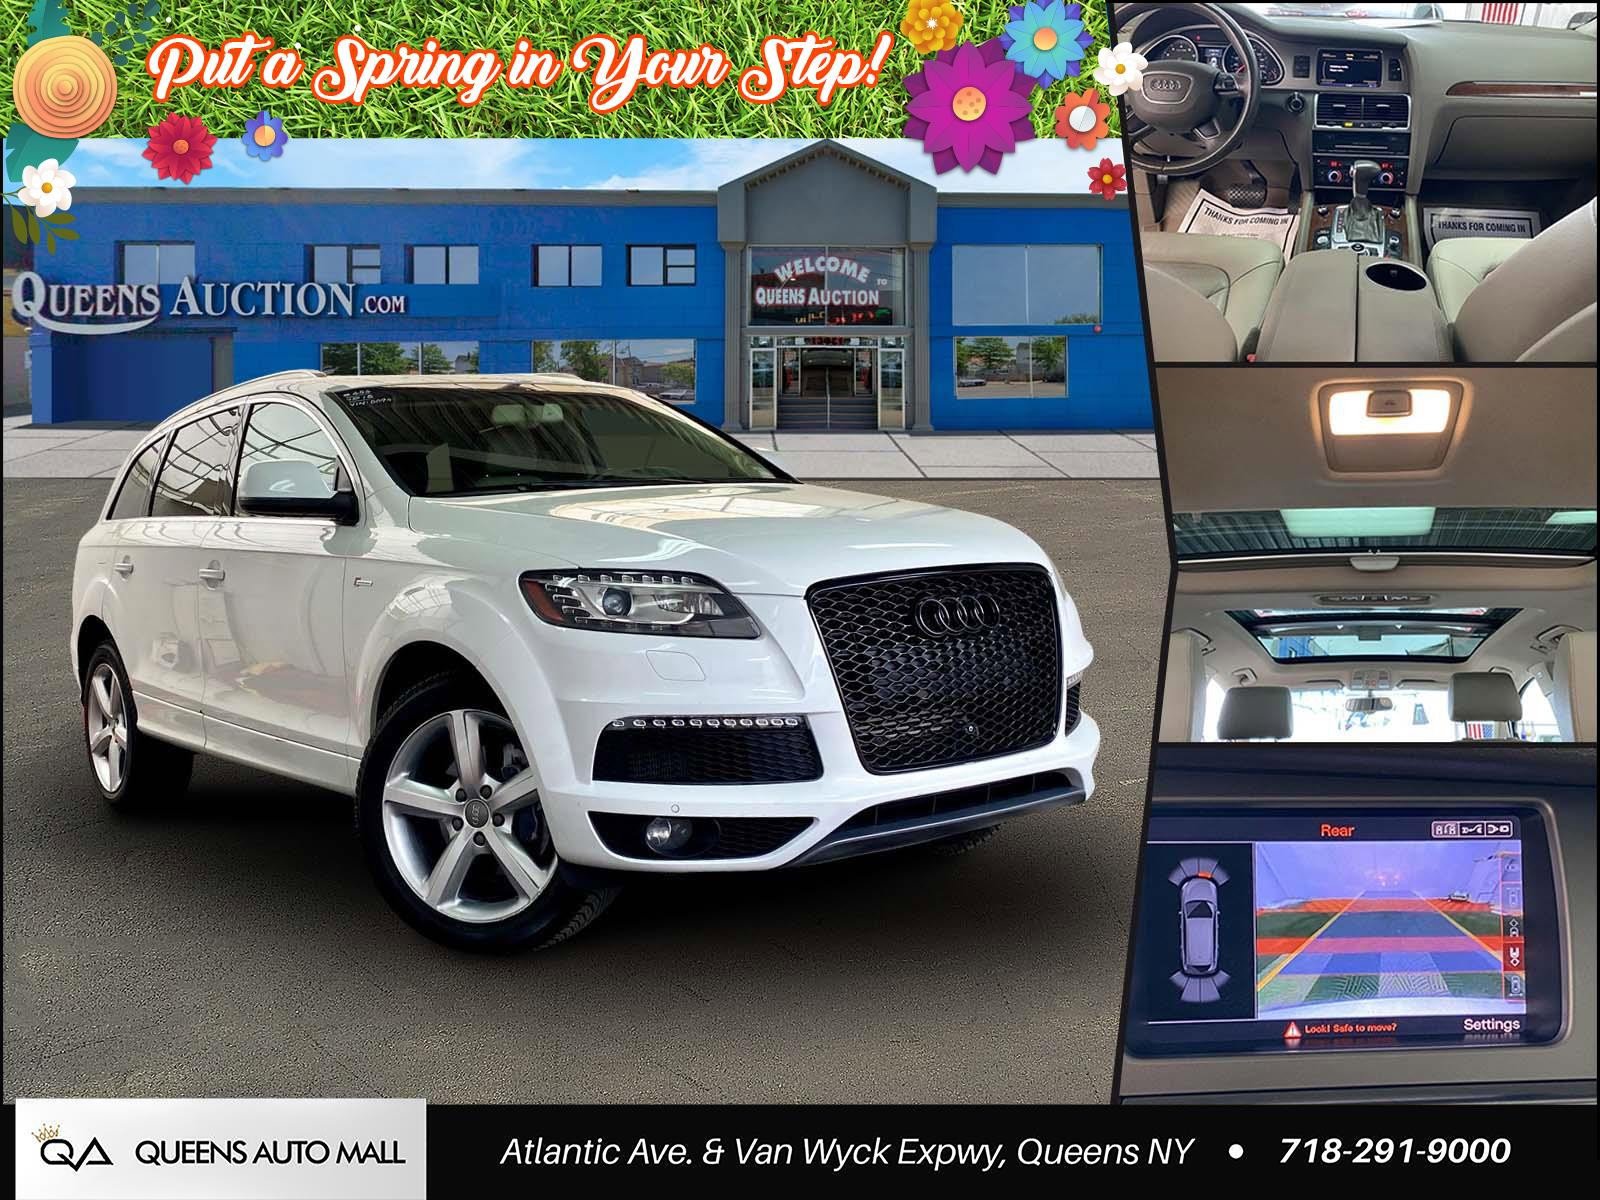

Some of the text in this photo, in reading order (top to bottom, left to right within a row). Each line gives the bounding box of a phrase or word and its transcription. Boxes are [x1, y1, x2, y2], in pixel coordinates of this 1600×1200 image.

[1203, 206, 1233, 225] THANKS
[1249, 216, 1279, 225] COMING
[1280, 217, 1288, 225] IN
[1438, 220, 1526, 233] THANKS FOR COMING IN
[774, 255, 871, 284] WELCOME
[877, 278, 888, 286] TO
[12, 271, 161, 335] QUEENS
[169, 276, 356, 317] AUCTION
[755, 286, 880, 306] QUEENS AUCTION
[1321, 824, 1355, 837] Rear
[1304, 1022, 1398, 1034] Look! Safe to move?
[1463, 1018, 1521, 1033] Settings
